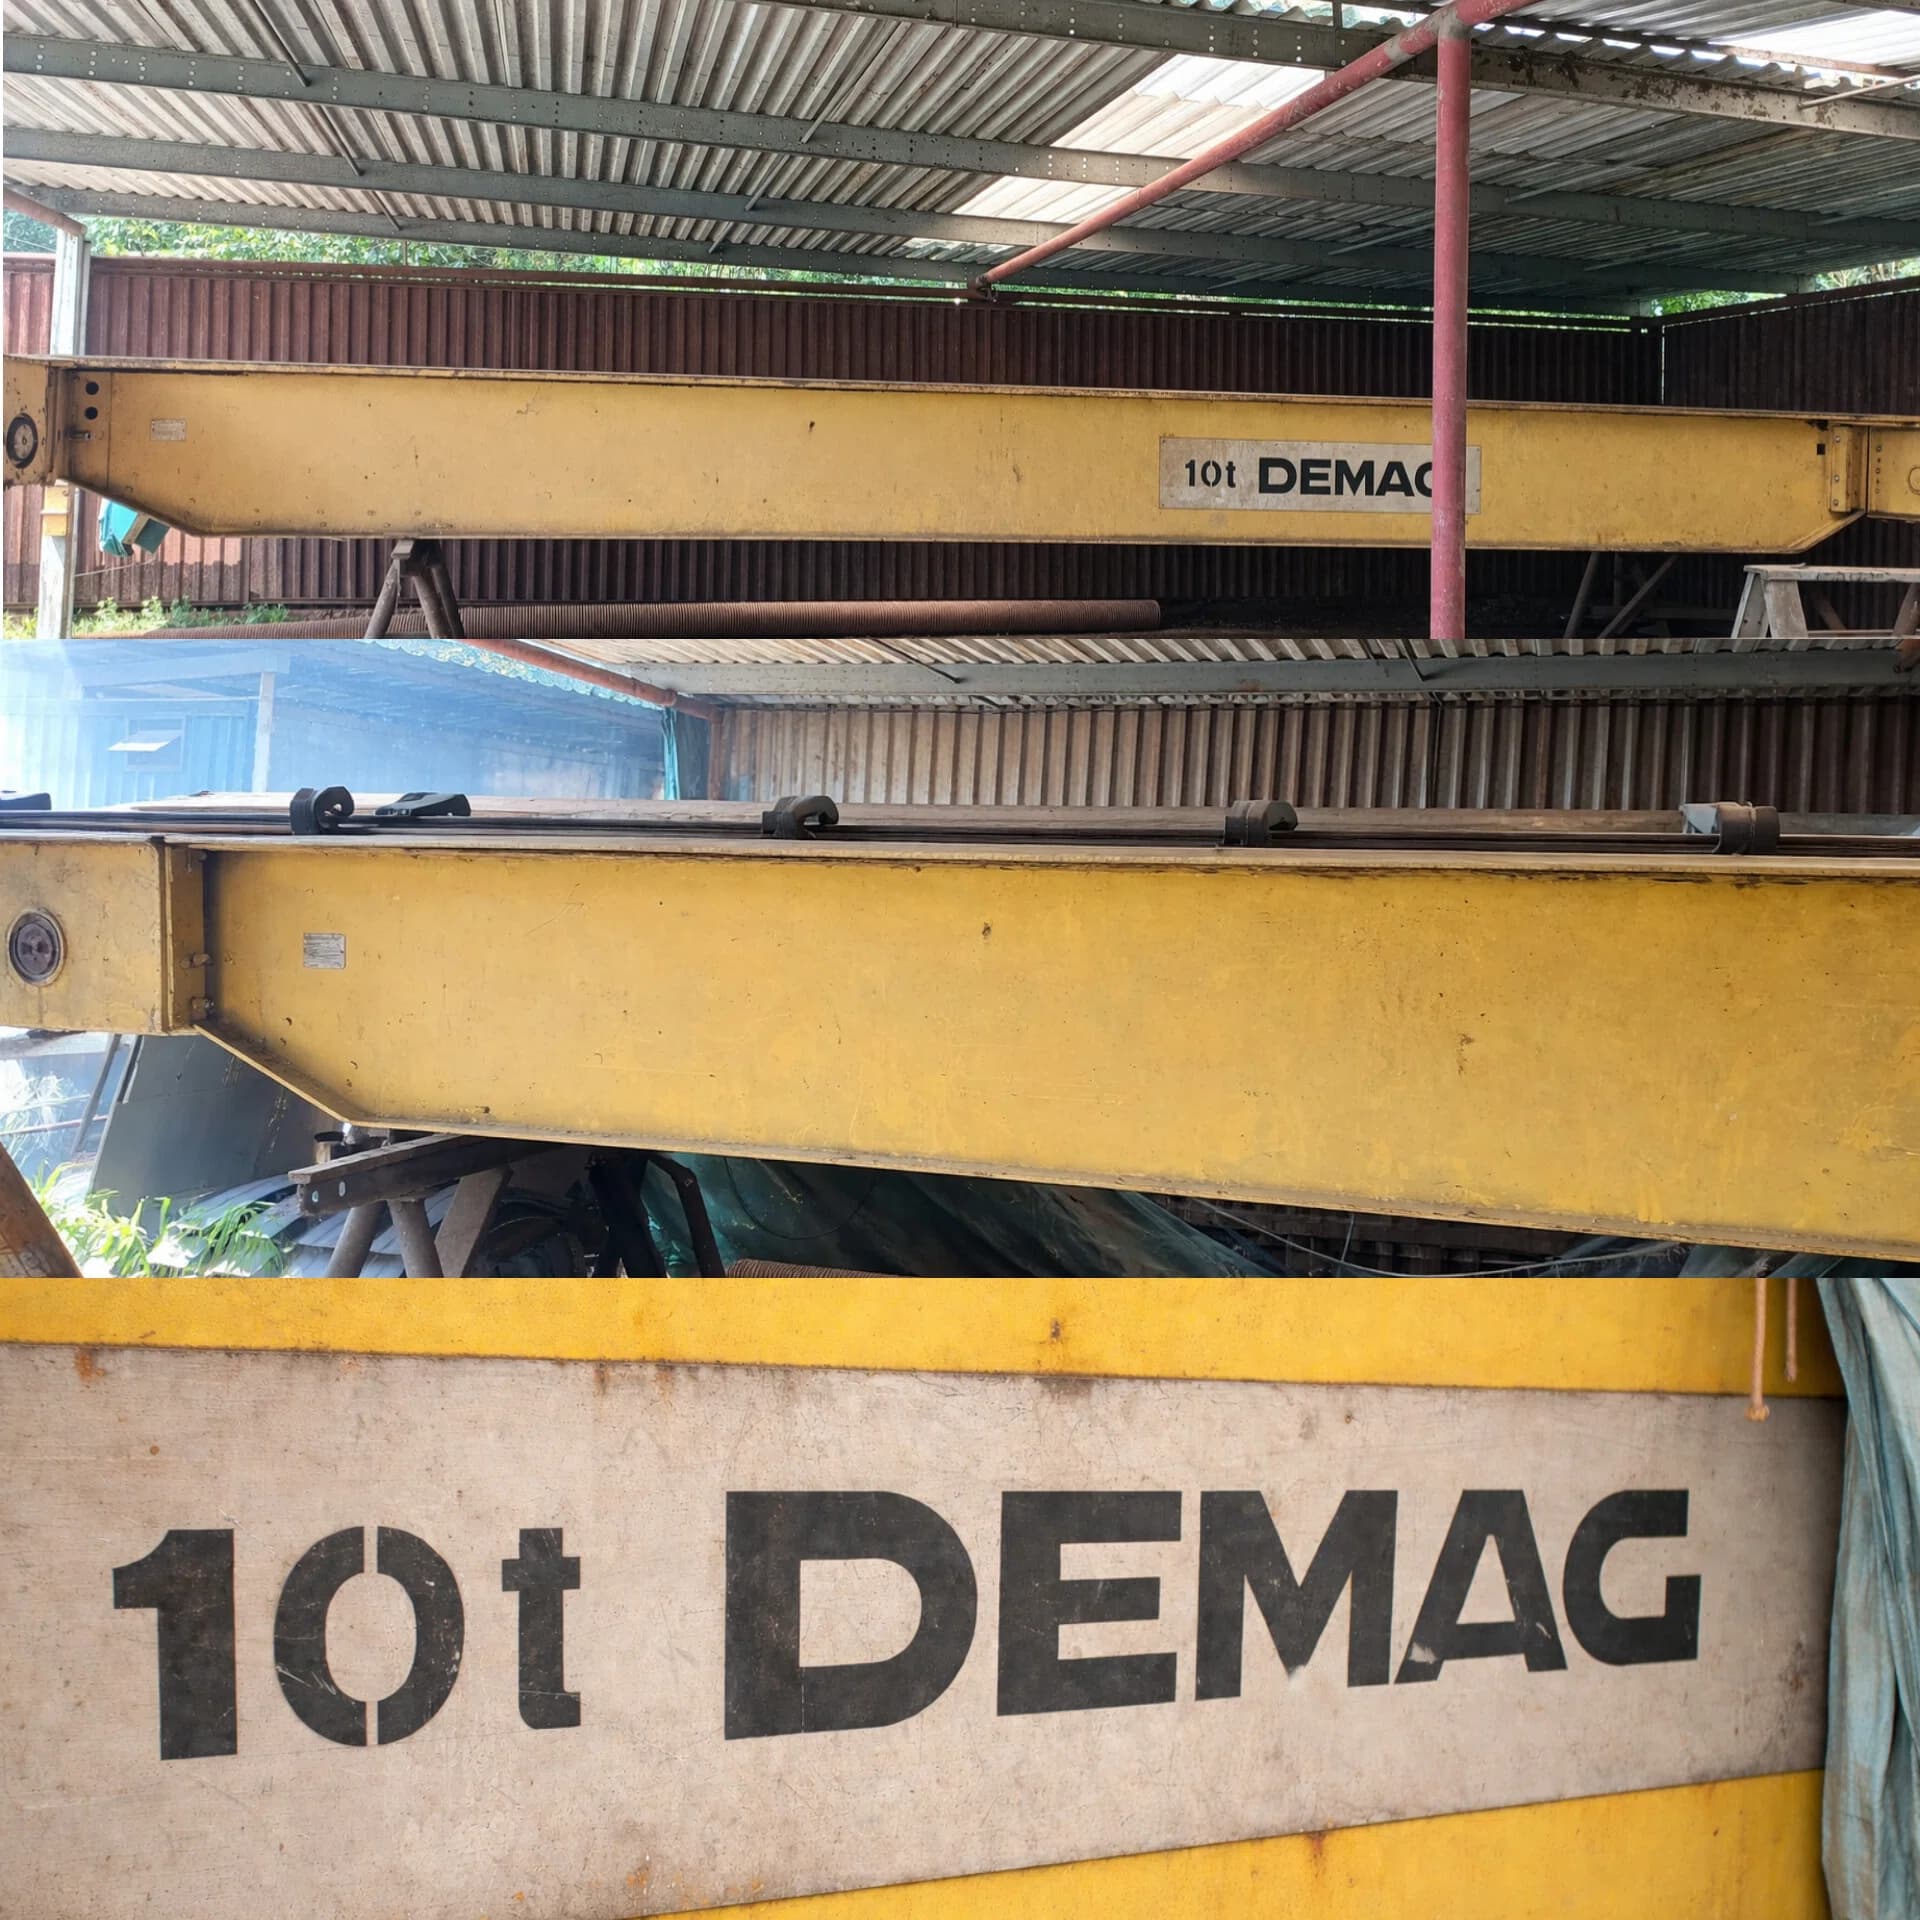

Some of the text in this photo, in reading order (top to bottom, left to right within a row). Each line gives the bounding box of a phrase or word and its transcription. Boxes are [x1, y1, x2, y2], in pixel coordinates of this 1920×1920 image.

[1184, 459, 1236, 488] 10t
[112, 1488, 1702, 1762] 10t DEMAG
